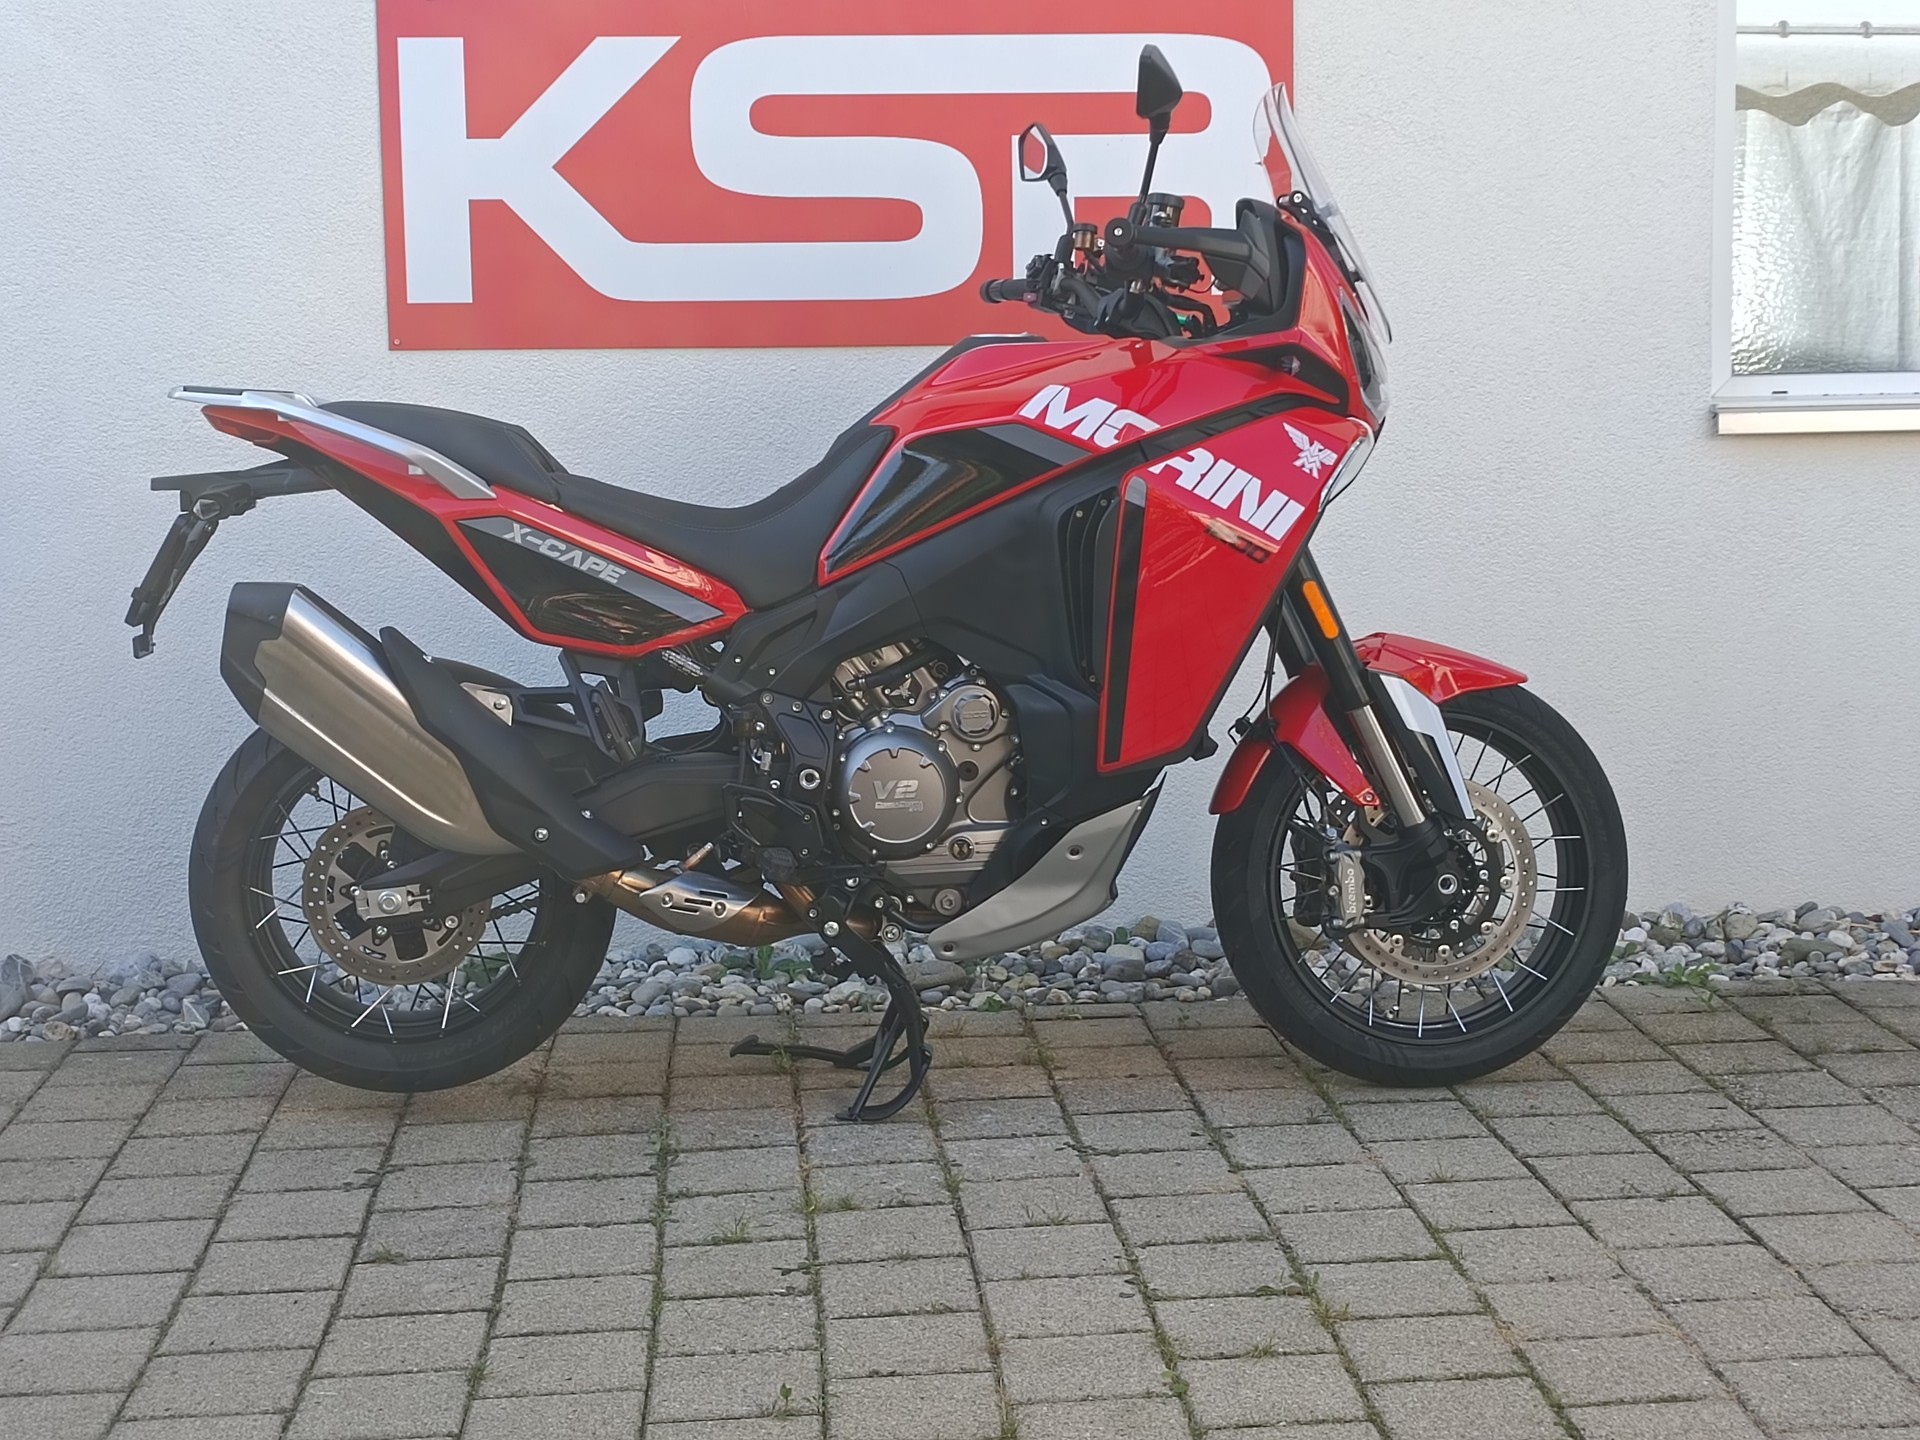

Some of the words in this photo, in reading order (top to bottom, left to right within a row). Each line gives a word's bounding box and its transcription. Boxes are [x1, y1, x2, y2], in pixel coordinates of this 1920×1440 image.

[397, 33, 1276, 305] KSR
[503, 522, 627, 584] X-CAPE
[873, 780, 919, 799] V2
[1344, 868, 1356, 913] brembo
